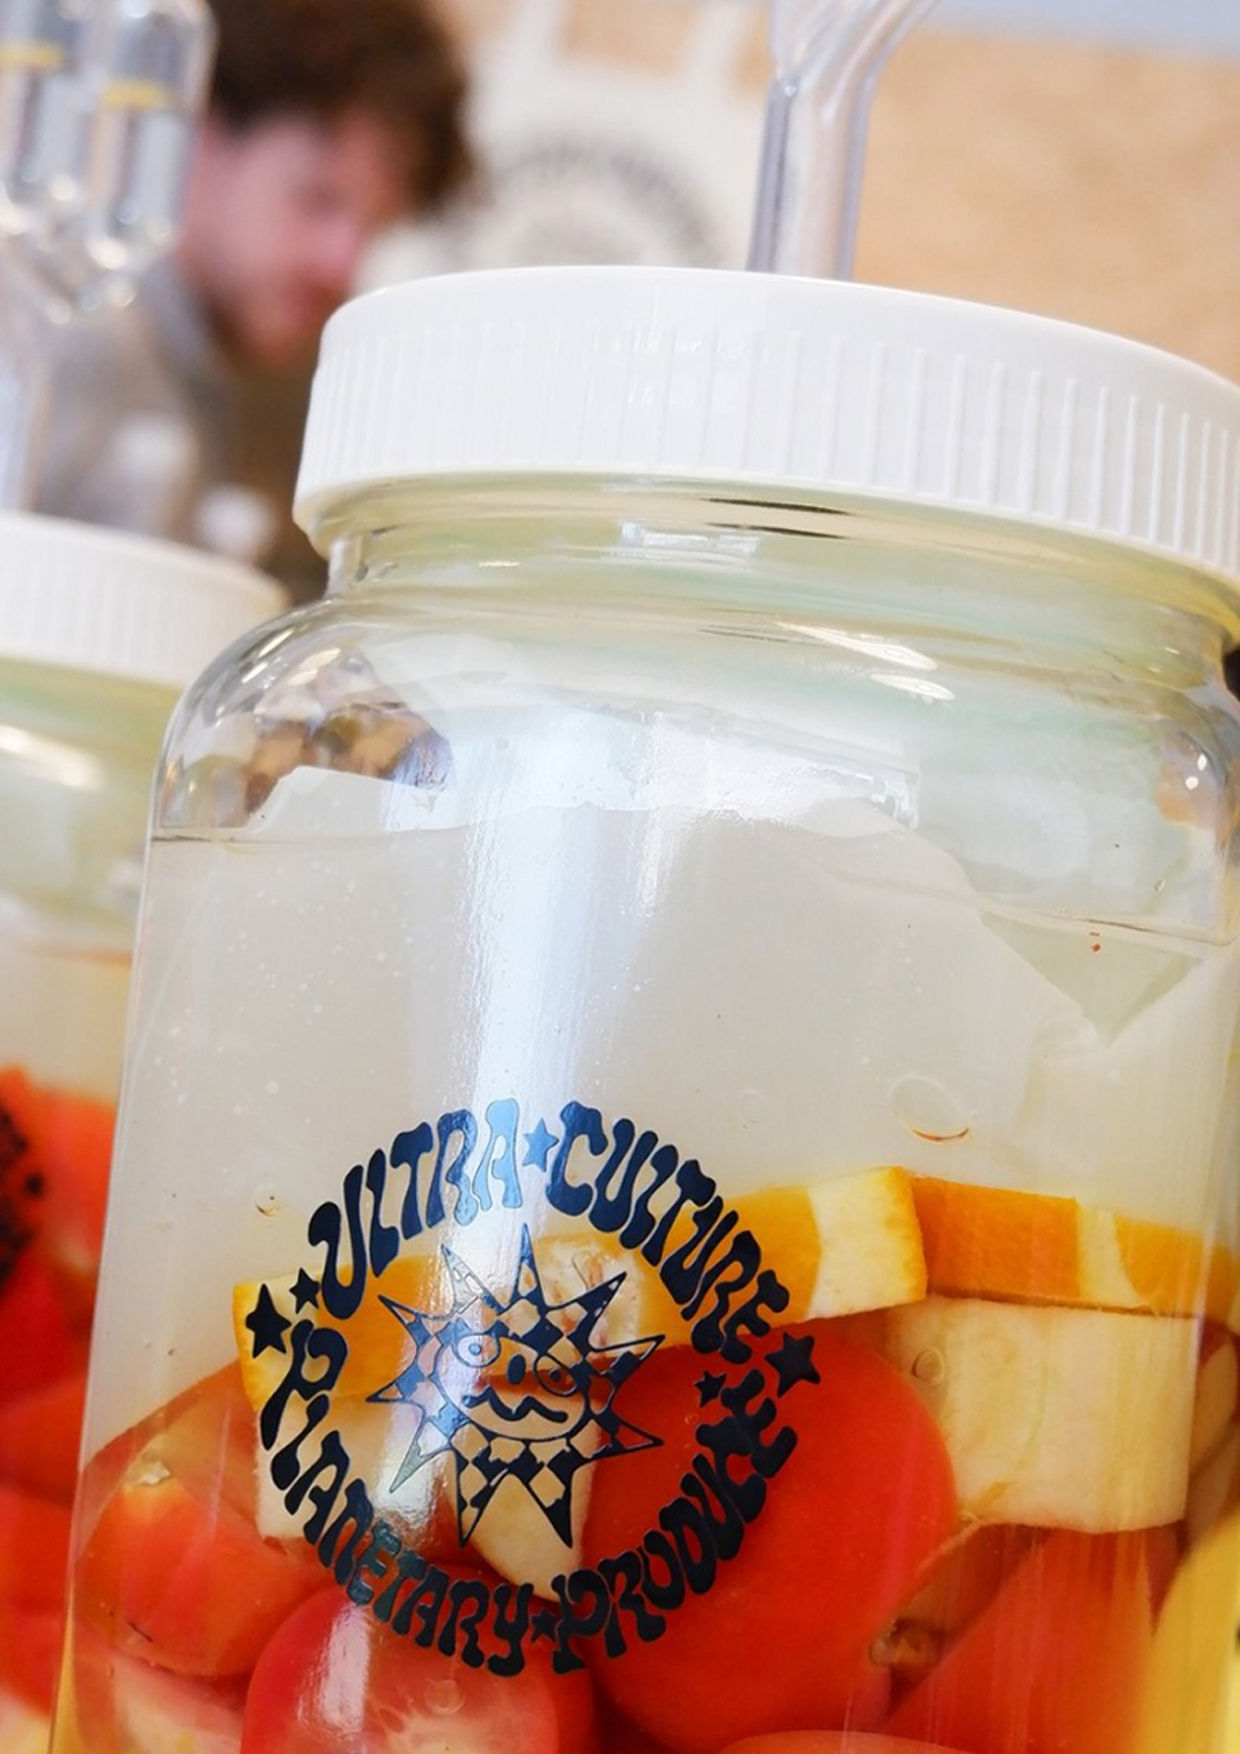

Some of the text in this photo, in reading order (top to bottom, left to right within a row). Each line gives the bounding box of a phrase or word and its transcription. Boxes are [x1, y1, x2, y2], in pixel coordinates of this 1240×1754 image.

[308, 1097, 524, 1320] ULTRA
[546, 1100, 791, 1364] CULTURE
[259, 1318, 798, 1677] PLANETARY PRODUCE
